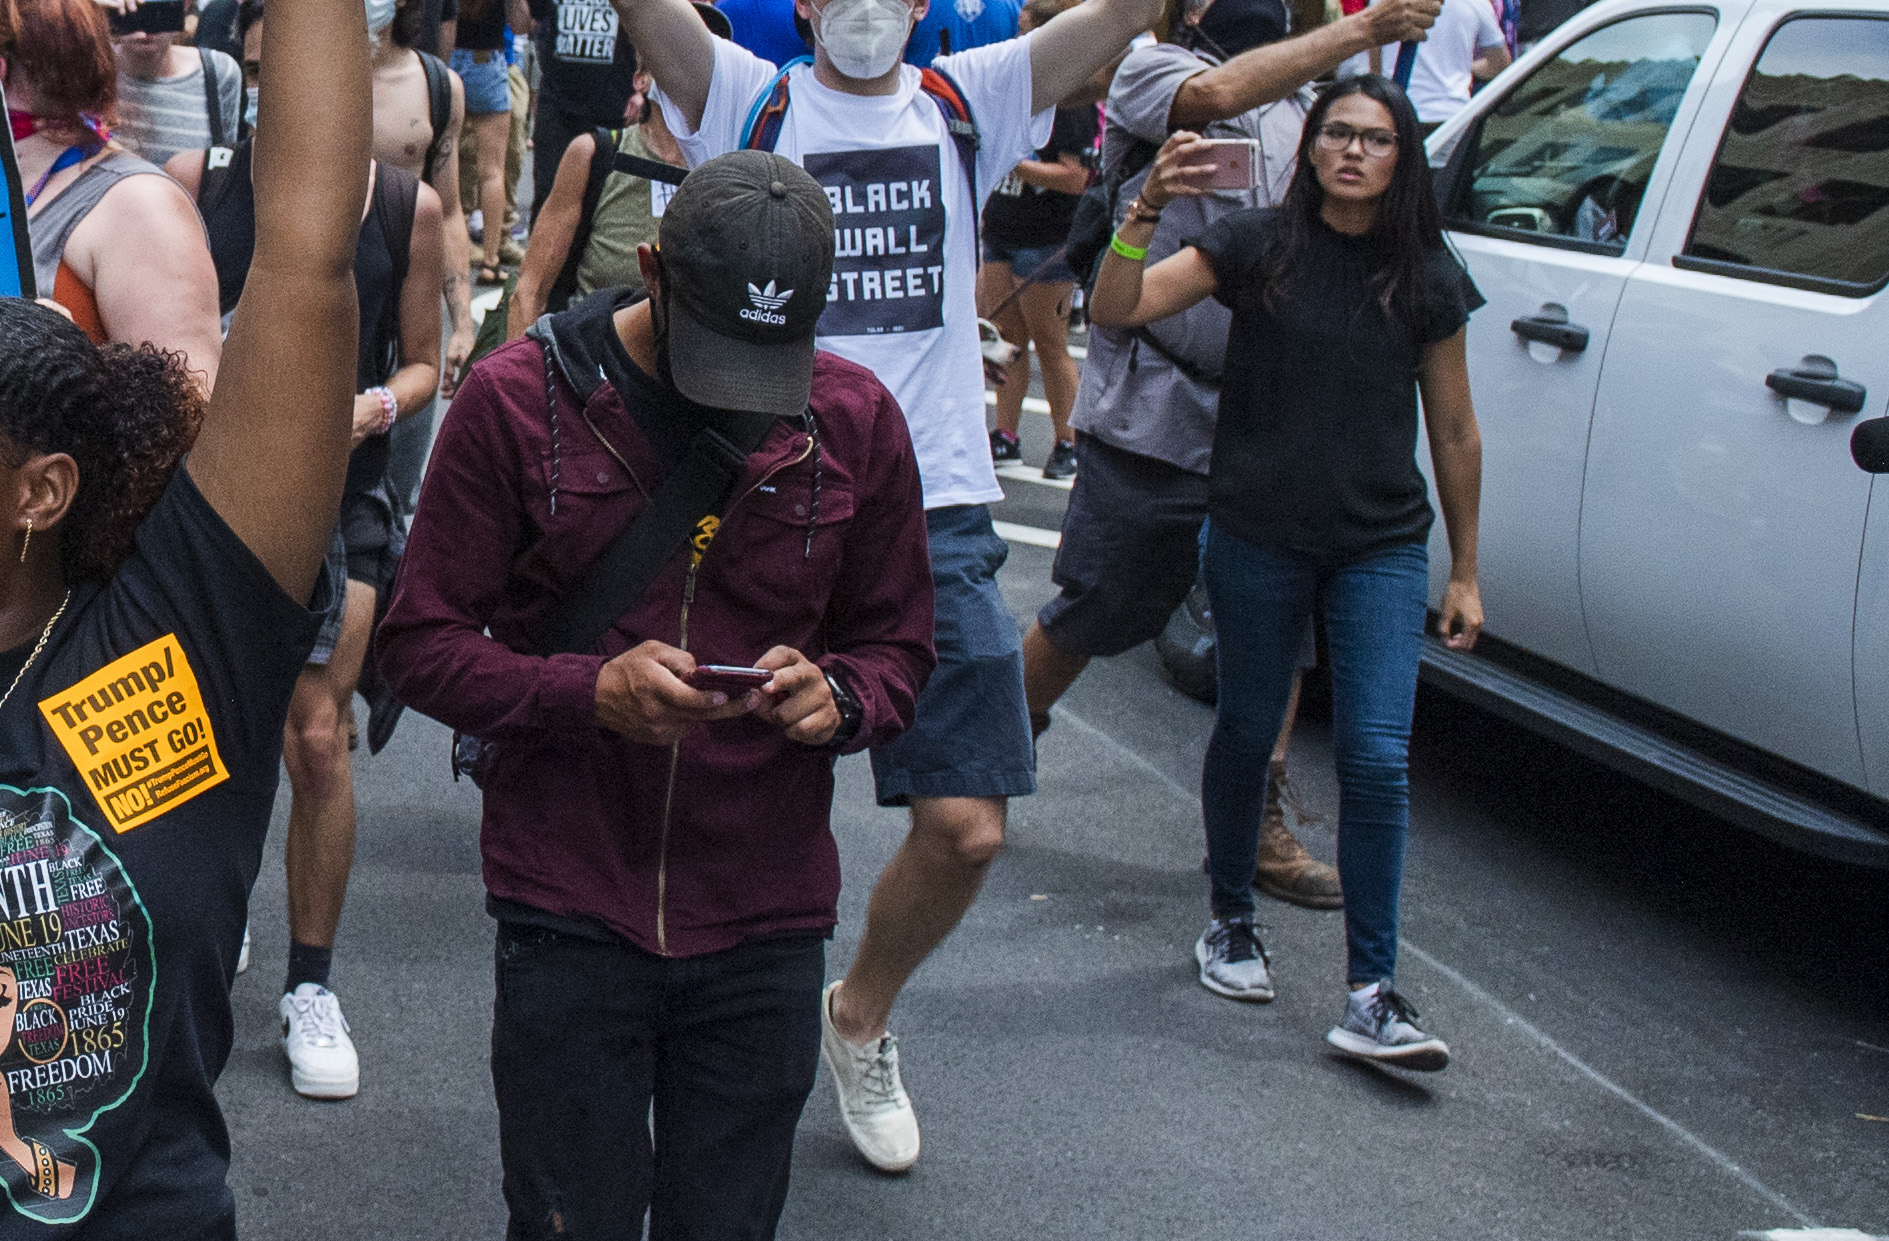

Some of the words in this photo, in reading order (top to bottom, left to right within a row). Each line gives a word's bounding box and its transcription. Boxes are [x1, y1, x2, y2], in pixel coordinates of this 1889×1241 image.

[563, 8, 613, 34] LIVES
[826, 178, 932, 214] BLACK
[834, 224, 928, 257] WALL
[825, 265, 943, 302] STREET
[739, 307, 786, 325] adidas
[51, 646, 175, 730] Trump/
[78, 691, 187, 757] Pence
[88, 738, 162, 791] MUST
[167, 717, 206, 753] GO!
[110, 783, 154, 820] NO!
[0, 836, 34, 857] FREE
[9, 845, 50, 866] JUNE
[55, 844, 69, 857] 19
[48, 857, 82, 872] BLACK
[52, 870, 69, 905] TEXAS
[70, 877, 105, 900] FREE
[39, 912, 62, 944] 19
[64, 920, 120, 951] TEXAS
[53, 938, 129, 965] CELEBRATE
[14, 957, 55, 980] FREE
[55, 955, 110, 986] FREE
[17, 977, 52, 1000] TEXAS
[52, 970, 129, 1002] FESTIVAL
[80, 982, 131, 1006] BLACK
[15, 1008, 58, 1032] BLACK
[69, 1014, 109, 1032] JUNE
[112, 1007, 125, 1022] 19
[68, 1000, 115, 1020] PRIDE
[29, 1038, 60, 1056] TEXAS
[70, 1021, 124, 1057] 1865
[6, 1050, 113, 1094] FREEDOM
[29, 1084, 65, 1105] 1865
